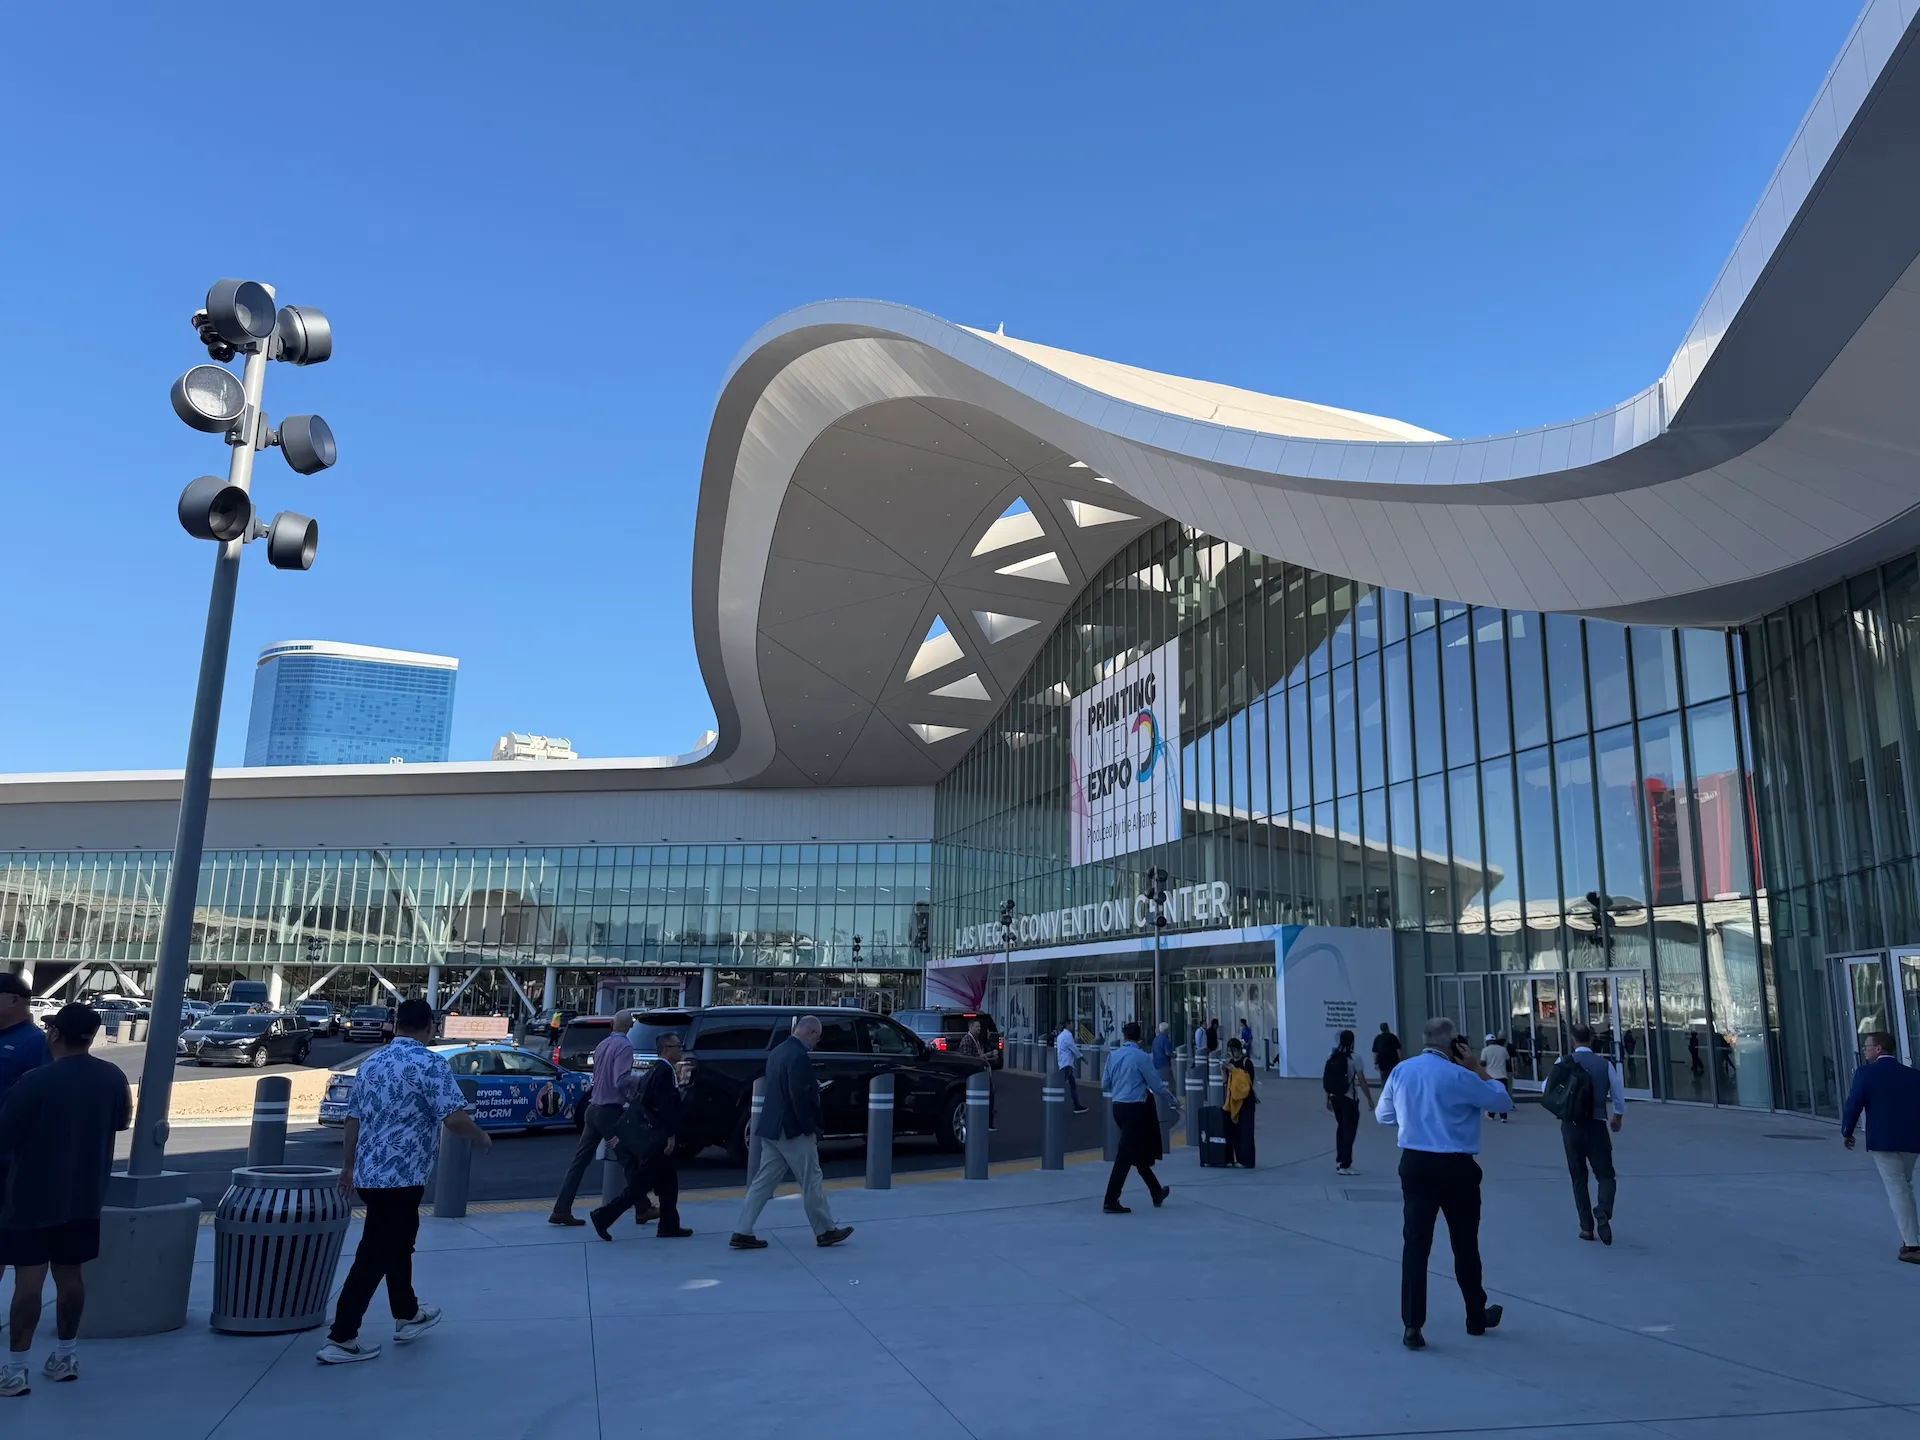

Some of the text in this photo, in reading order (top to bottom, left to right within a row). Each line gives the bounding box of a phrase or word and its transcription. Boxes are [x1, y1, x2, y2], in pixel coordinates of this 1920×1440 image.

[1088, 672, 1156, 736] PRINTING
[1087, 722, 1129, 769] UNITED
[1088, 757, 1132, 803] EXPO
[1087, 821, 1113, 845] Poduced
[955, 926, 975, 950] LAS
[1020, 897, 1131, 943] CONVENTION
[1133, 880, 1230, 928] CNTER
[476, 1089, 502, 1098] eryone
[491, 1097, 512, 1106] faster
[513, 1096, 529, 1105] with
[489, 1108, 512, 1118] CRM
